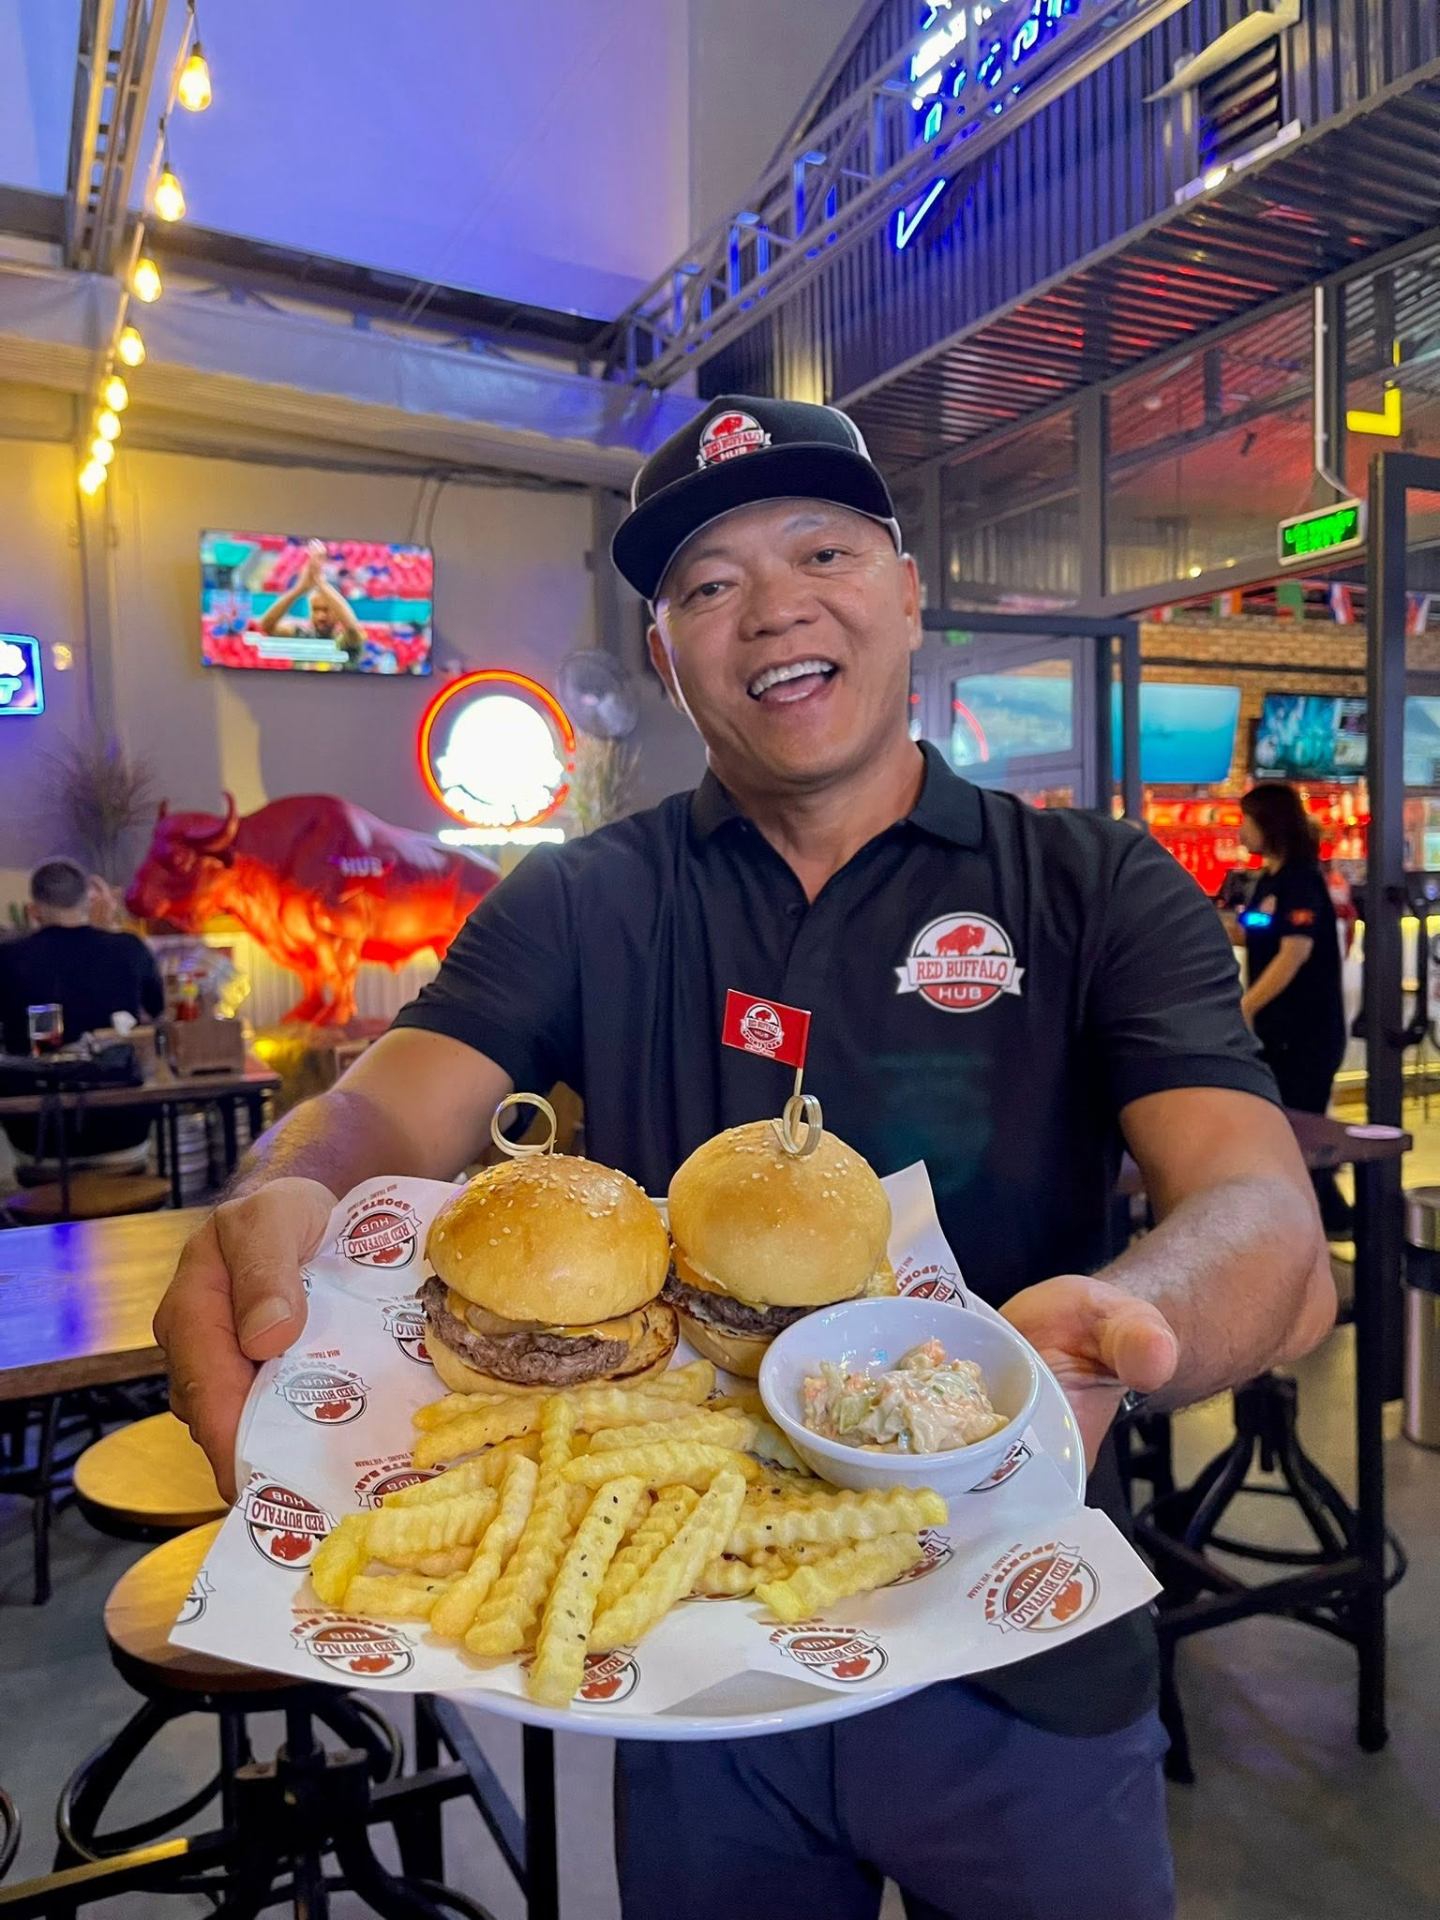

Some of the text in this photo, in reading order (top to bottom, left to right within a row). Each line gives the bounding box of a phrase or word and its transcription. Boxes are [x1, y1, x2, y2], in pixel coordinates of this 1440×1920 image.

[917, 959, 1008, 981] RED BUFFALO
[939, 987, 982, 1000] HUB
[362, 1198, 411, 1211] SPORTS
[360, 1217, 389, 1233] HUB
[348, 1222, 410, 1254] RED BUFFALO
[898, 1265, 938, 1294] SPORT
[934, 1282, 951, 1302] RED
[289, 1385, 358, 1402] RED BUFFALO
[355, 1470, 380, 1490] BAR
[386, 1476, 421, 1491] HUB
[272, 1491, 305, 1507] HUB
[252, 1500, 325, 1531] RED BUFFALO
[985, 1542, 1055, 1621] SPORTS BAR
[1011, 1557, 1074, 1624] RED BUFFALO
[1012, 1567, 1042, 1599] HUB
[291, 1616, 398, 1634] SPORTS BAR
[787, 1626, 856, 1634] SPORTS
[330, 1632, 370, 1640] HUB
[801, 1639, 836, 1650] HUB
[314, 1640, 401, 1654] RED BUFFALO
[793, 1640, 869, 1662] RED BUFFALO
[598, 1656, 625, 1675] RED
